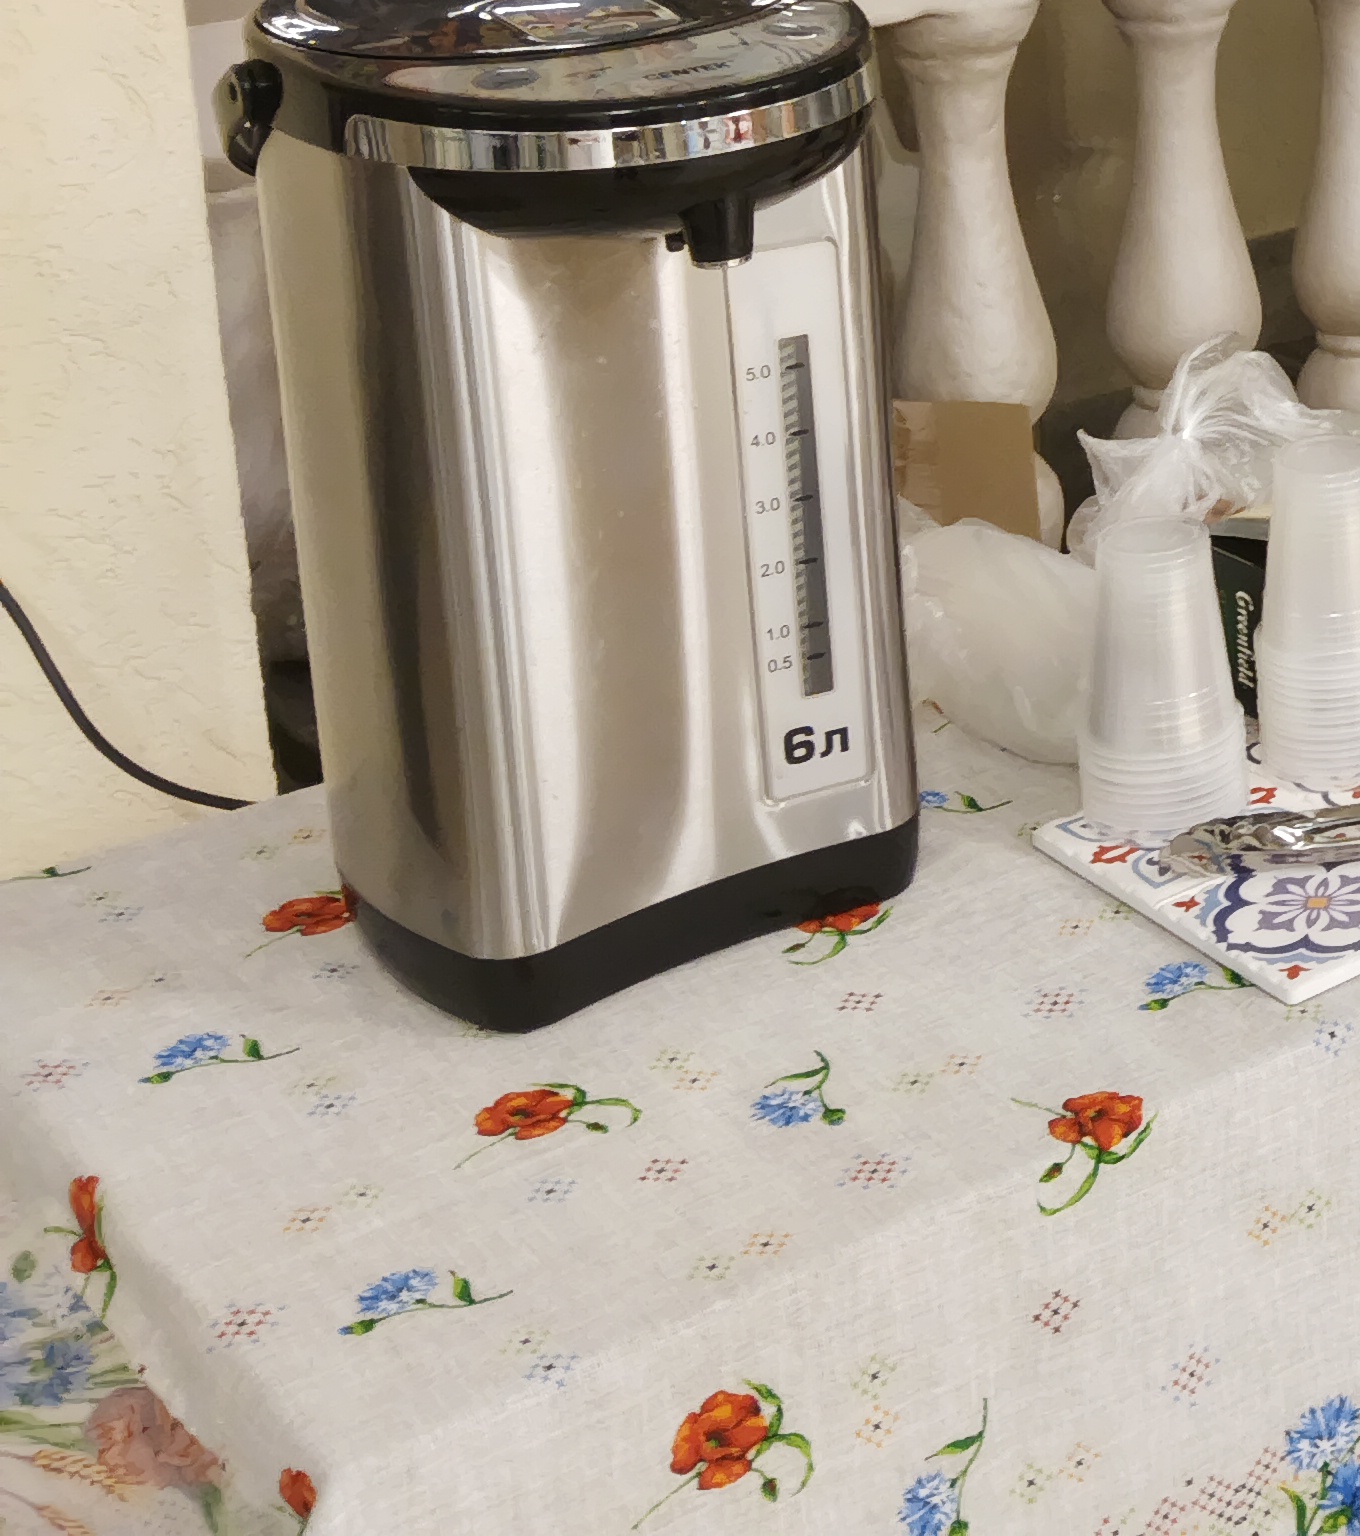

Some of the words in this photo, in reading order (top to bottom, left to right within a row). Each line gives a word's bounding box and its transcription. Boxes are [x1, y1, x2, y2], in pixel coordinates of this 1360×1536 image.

[745, 365, 771, 381] 5.0
[750, 431, 776, 448] 4.0
[755, 497, 781, 514] 3.0
[760, 560, 786, 577] 2.0
[766, 624, 791, 641] 1.0
[1235, 591, 1255, 688] Greenfield
[767, 656, 793, 672] 0.5
[783, 725, 850, 765] 6л
